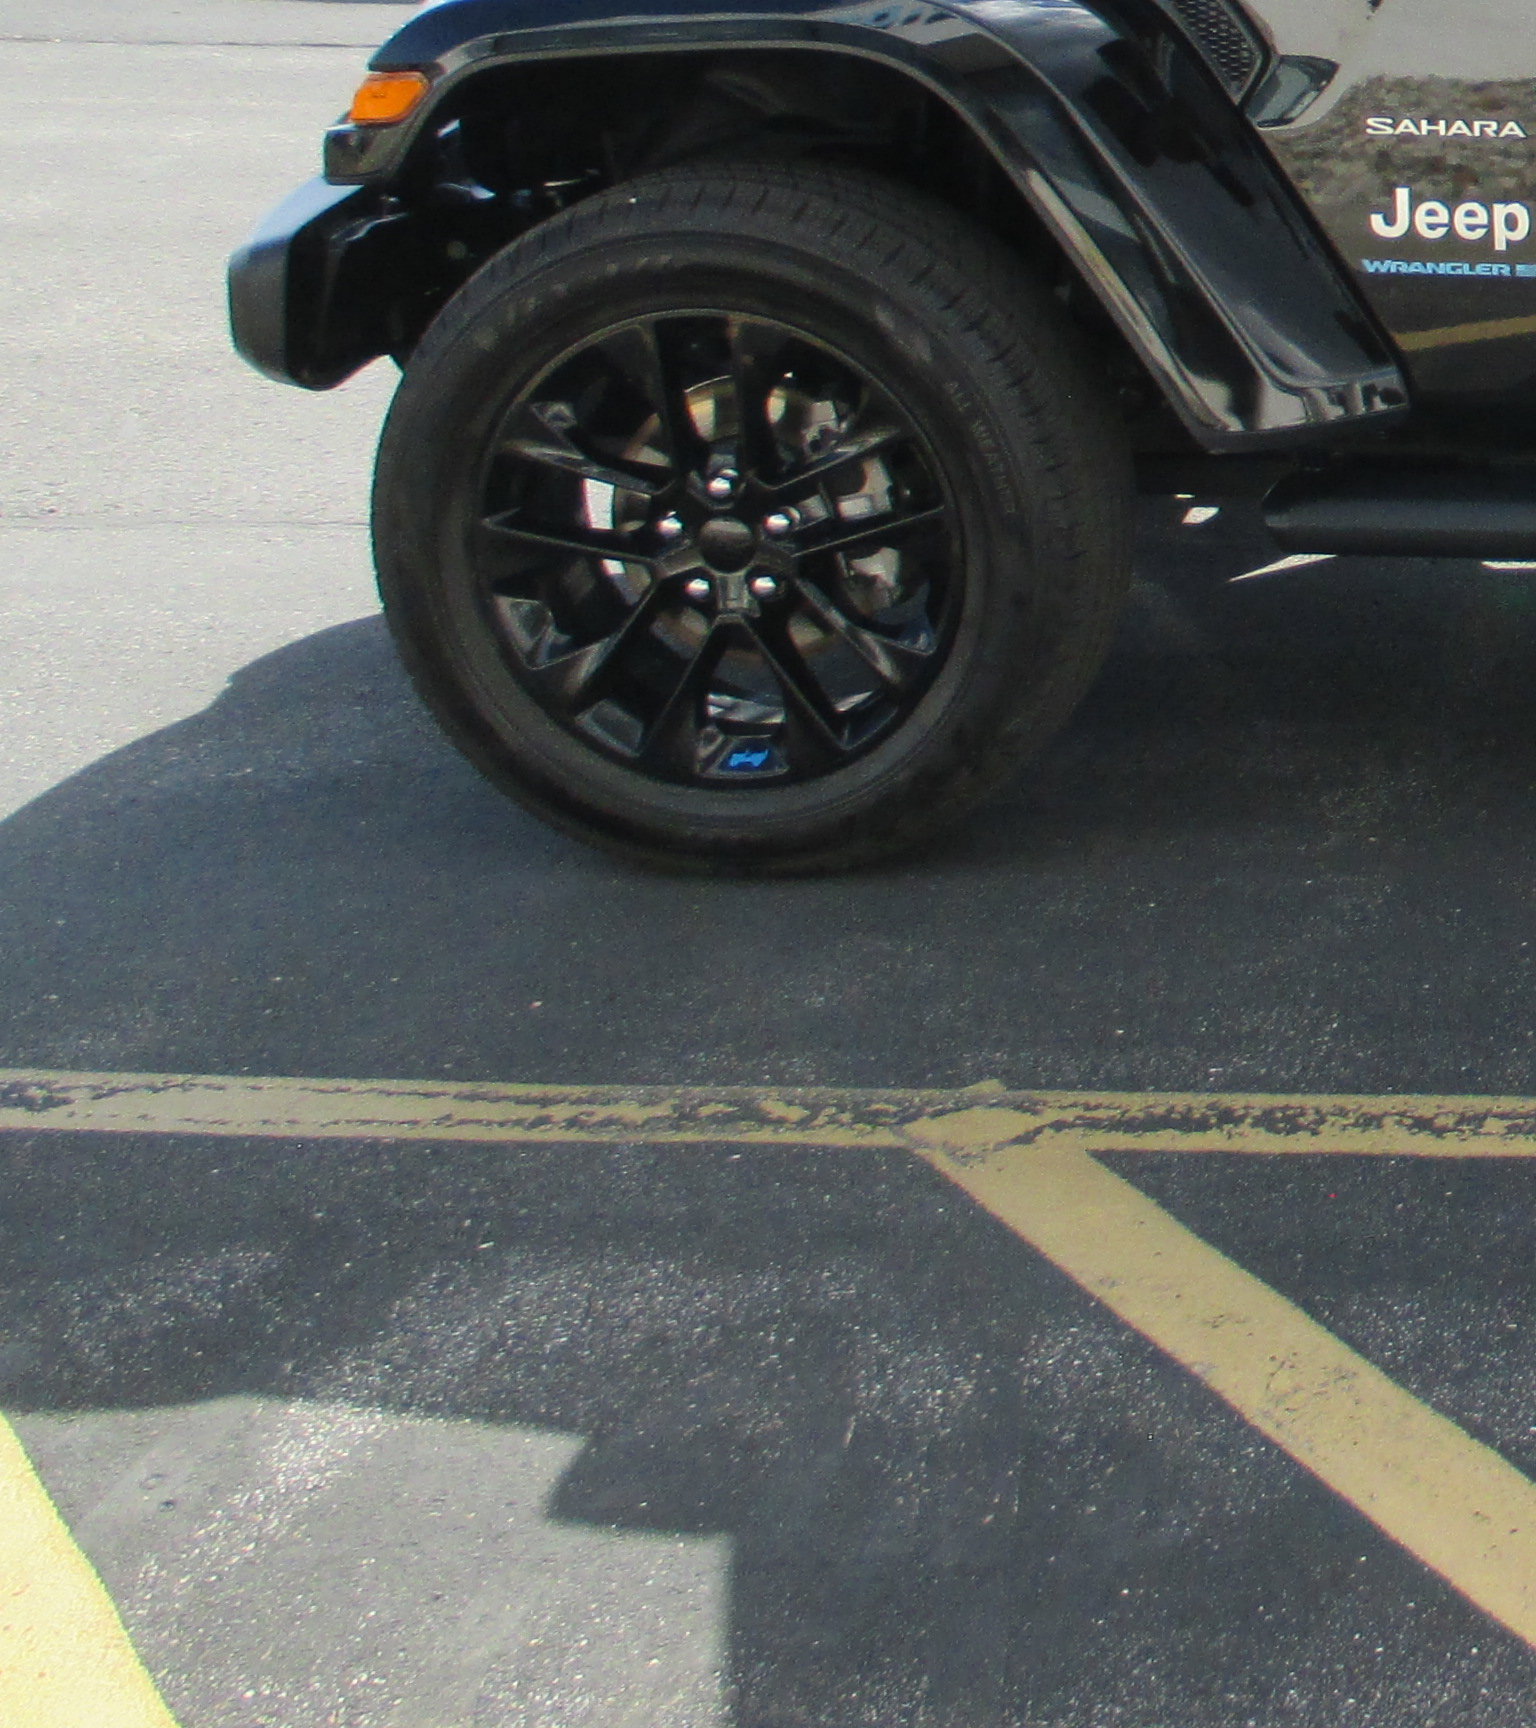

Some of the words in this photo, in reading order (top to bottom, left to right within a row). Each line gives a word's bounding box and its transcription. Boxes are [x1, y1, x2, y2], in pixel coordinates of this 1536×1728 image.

[1365, 116, 1527, 138] SAHARA
[1369, 186, 1530, 251] Jeep
[1361, 259, 1512, 277] WRANGLER
